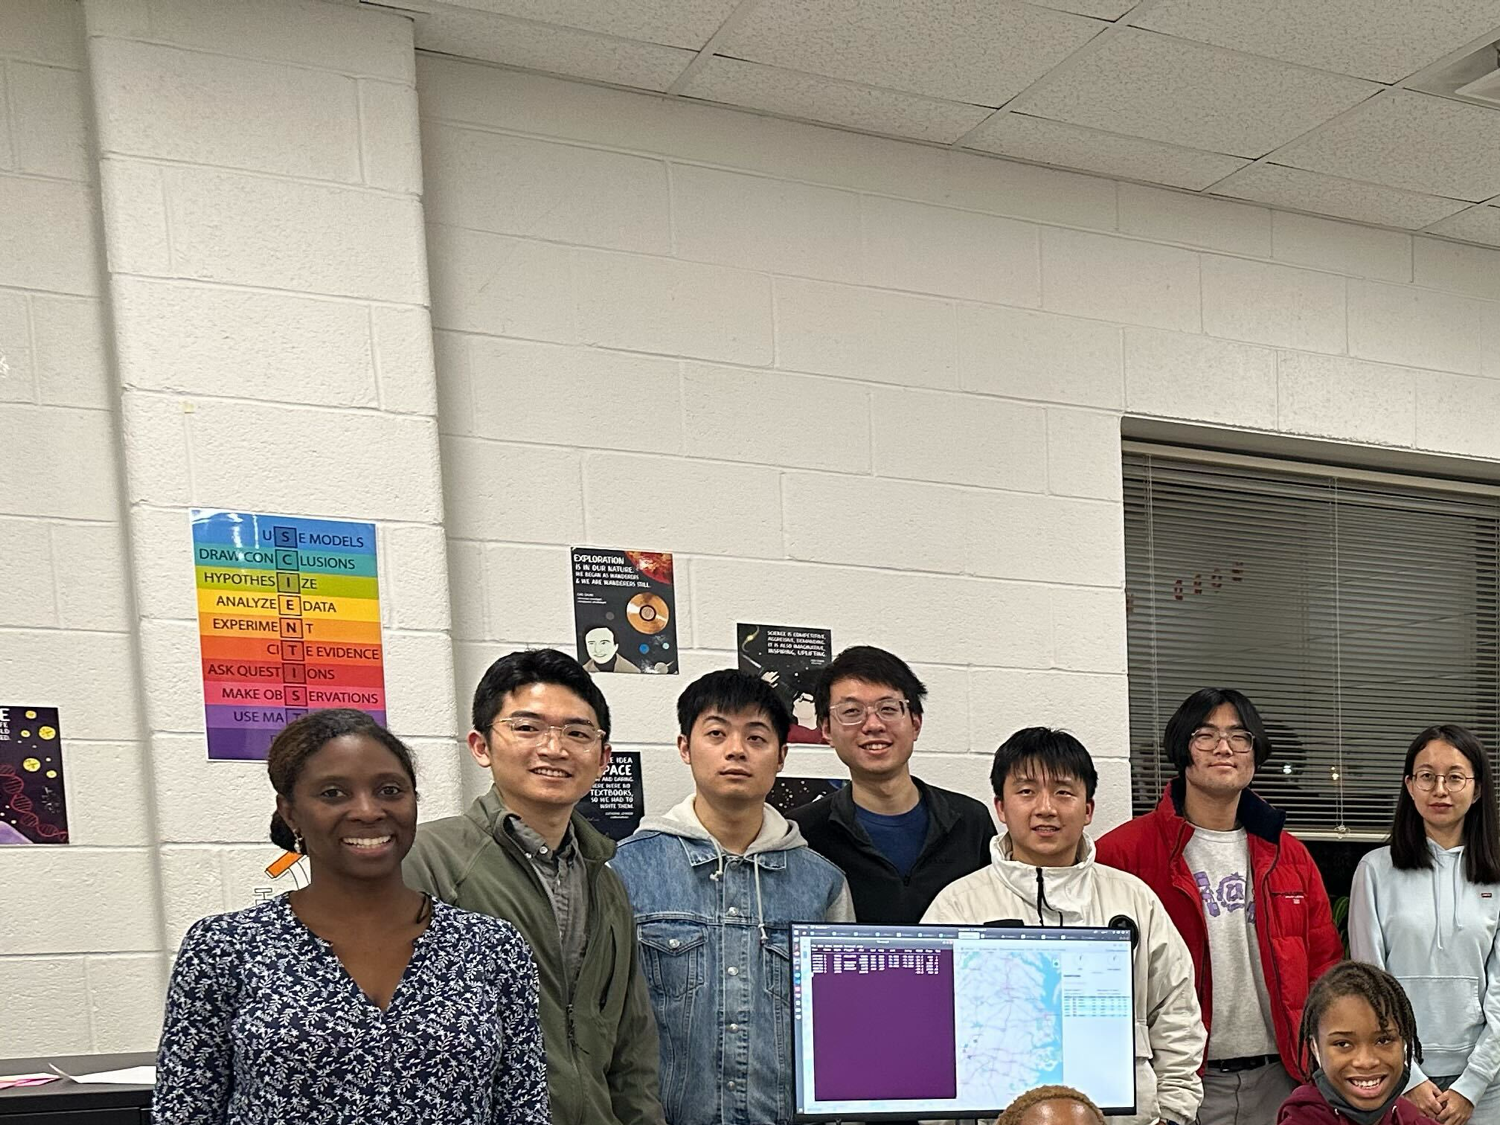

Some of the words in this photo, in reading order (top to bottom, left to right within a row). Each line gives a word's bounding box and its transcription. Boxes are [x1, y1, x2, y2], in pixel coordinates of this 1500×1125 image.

[309, 534, 364, 547] MODELS
[200, 548, 240, 562] DRAW
[244, 551, 356, 570] CONCLUSIONS
[573, 554, 625, 565] EXPLORATION
[204, 571, 318, 589] HYPOTHESIZE
[303, 600, 337, 613] DATA
[213, 618, 314, 634] EXPERIMENT
[316, 647, 379, 660] EVIDENCE
[208, 663, 234, 676] ASK
[237, 665, 335, 680] QUESTIONS
[222, 688, 260, 700] MAKE
[263, 689, 379, 704] OBSERVATIONS
[234, 711, 260, 722] USE
[602, 765, 632, 776] PACE
